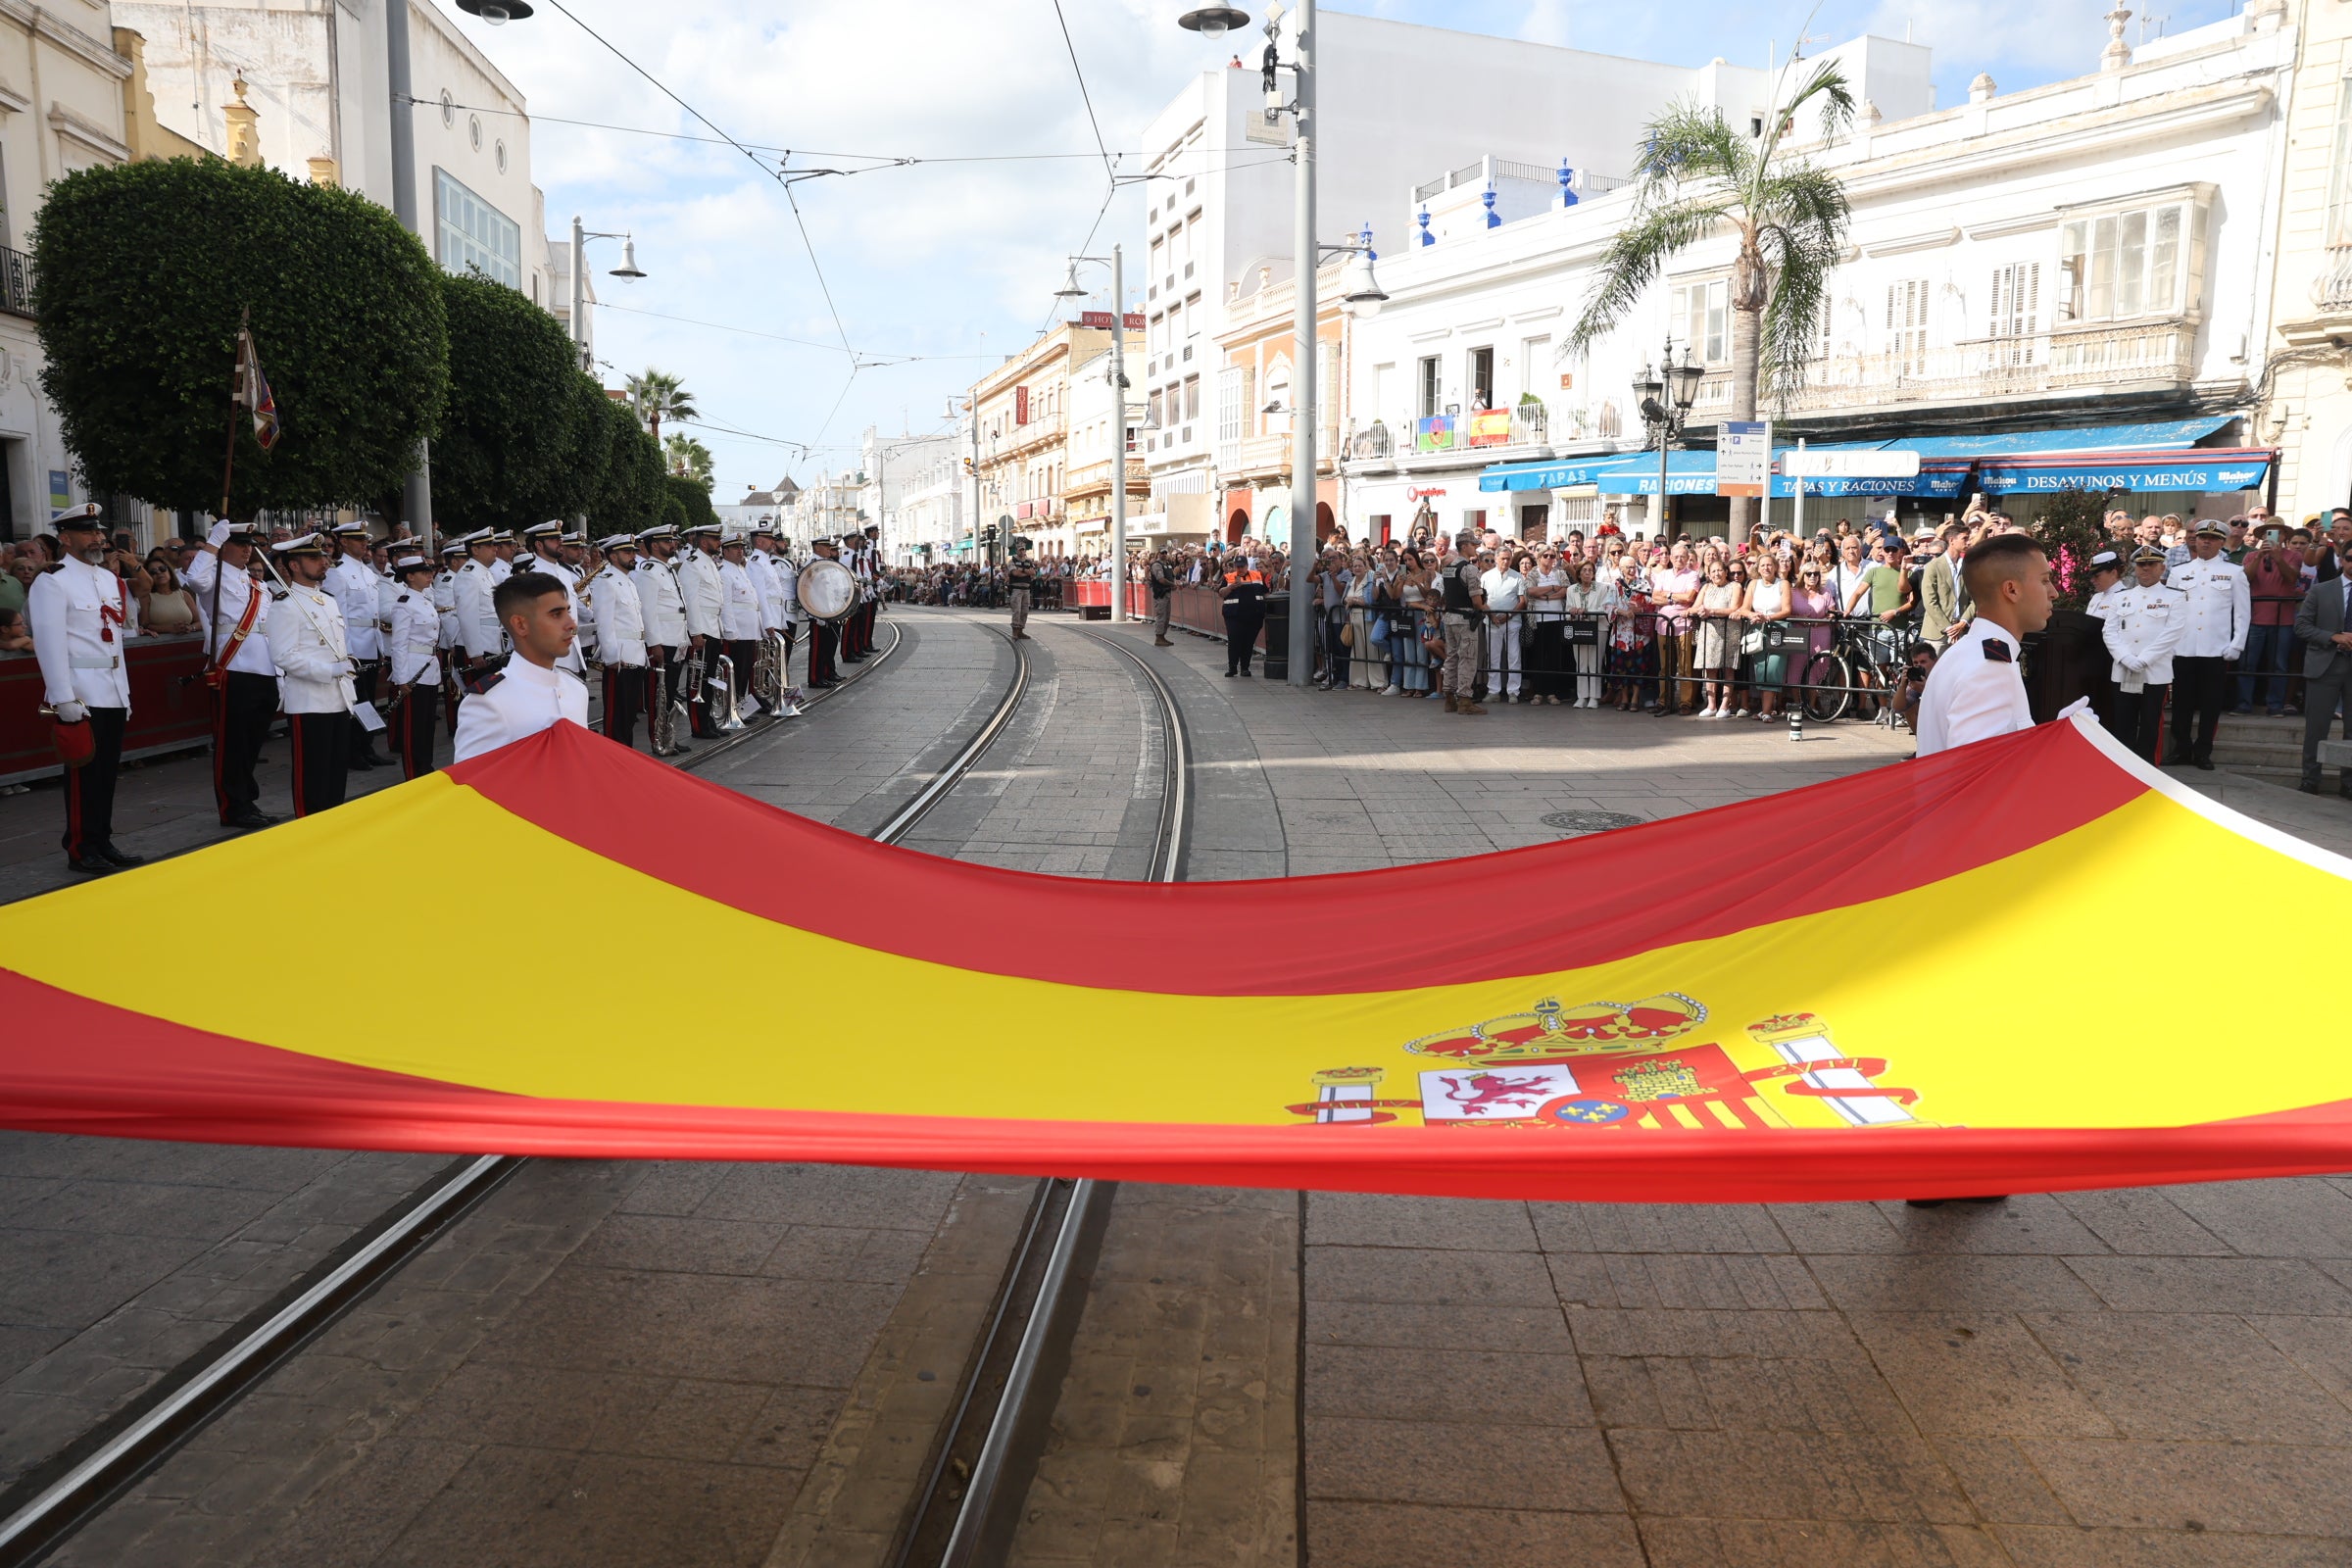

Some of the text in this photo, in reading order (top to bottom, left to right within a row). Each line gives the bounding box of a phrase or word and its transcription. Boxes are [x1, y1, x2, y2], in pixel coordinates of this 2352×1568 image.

[1538, 470, 1587, 483] TAPAS
[2027, 470, 2207, 488] DESAYUNOS Y MENÚS
[1828, 481, 1838, 492] Y
[1840, 480, 1915, 492] RACIONES
